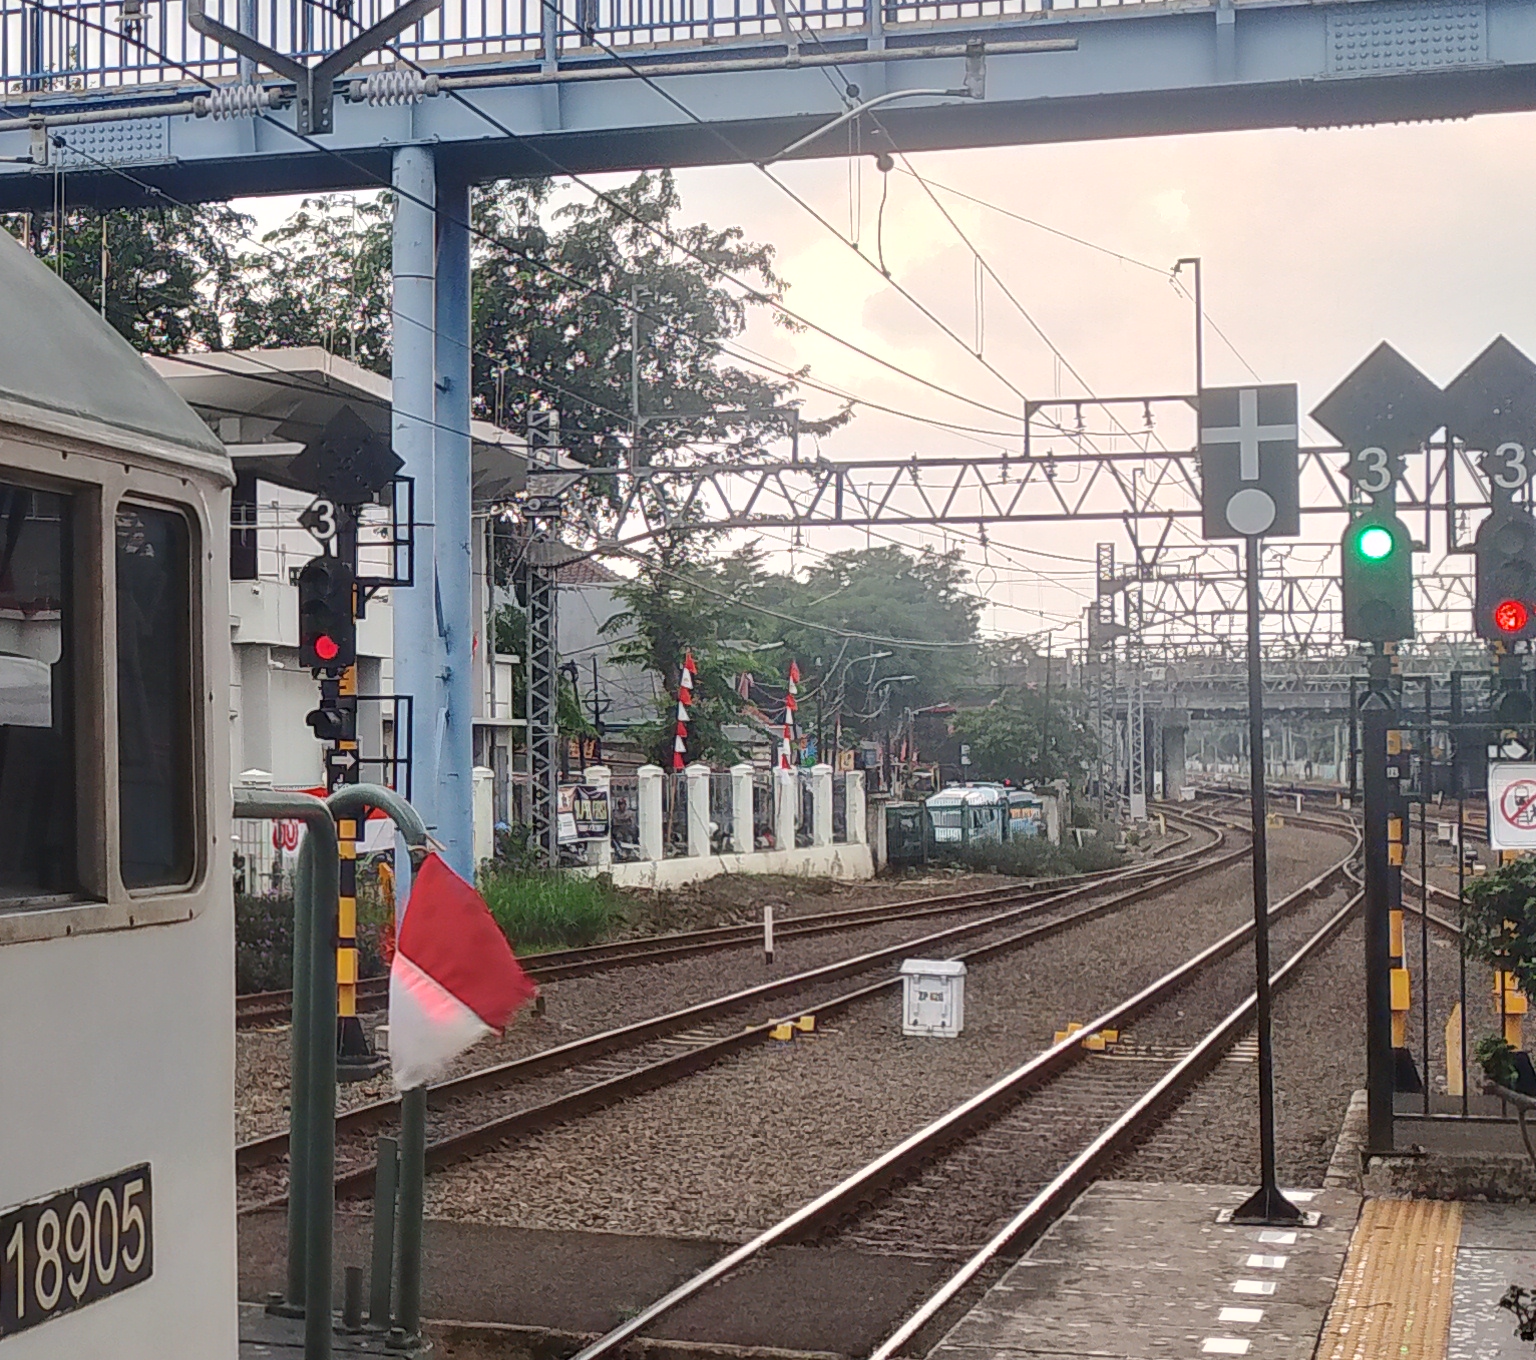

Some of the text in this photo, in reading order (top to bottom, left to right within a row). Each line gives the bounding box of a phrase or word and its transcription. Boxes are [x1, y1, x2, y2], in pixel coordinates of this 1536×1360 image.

[1358, 447, 1391, 492] 3
[1494, 442, 1527, 488] 3
[310, 500, 335, 539] 3
